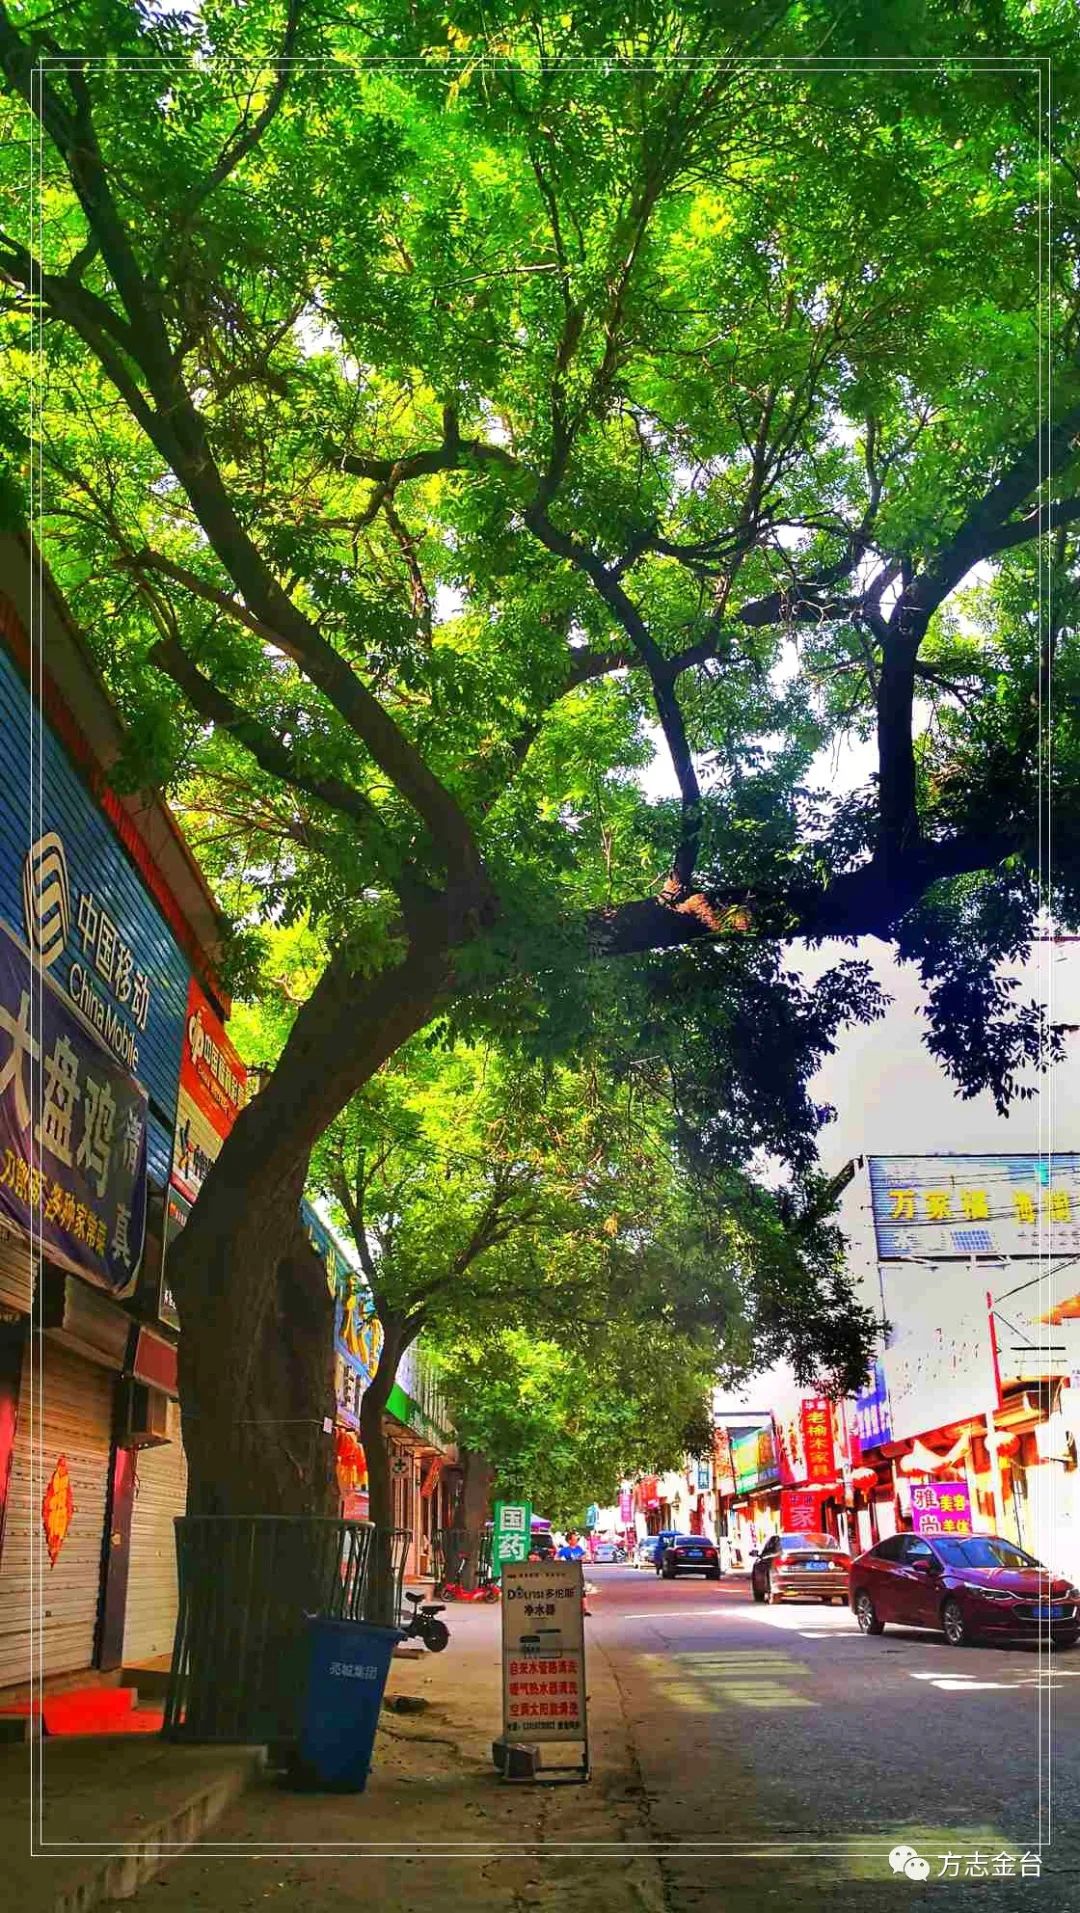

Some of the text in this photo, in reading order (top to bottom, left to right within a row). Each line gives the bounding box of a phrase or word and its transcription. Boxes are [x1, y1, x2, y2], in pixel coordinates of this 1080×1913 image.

[70, 963, 139, 1071] China Mobile
[78, 893, 150, 1030] 中国移动
[0, 990, 117, 1198] 大盘鸡
[112, 1106, 143, 1268] 清真
[498, 1505, 526, 1560] 国药
[523, 1603, 555, 1616] 净水器
